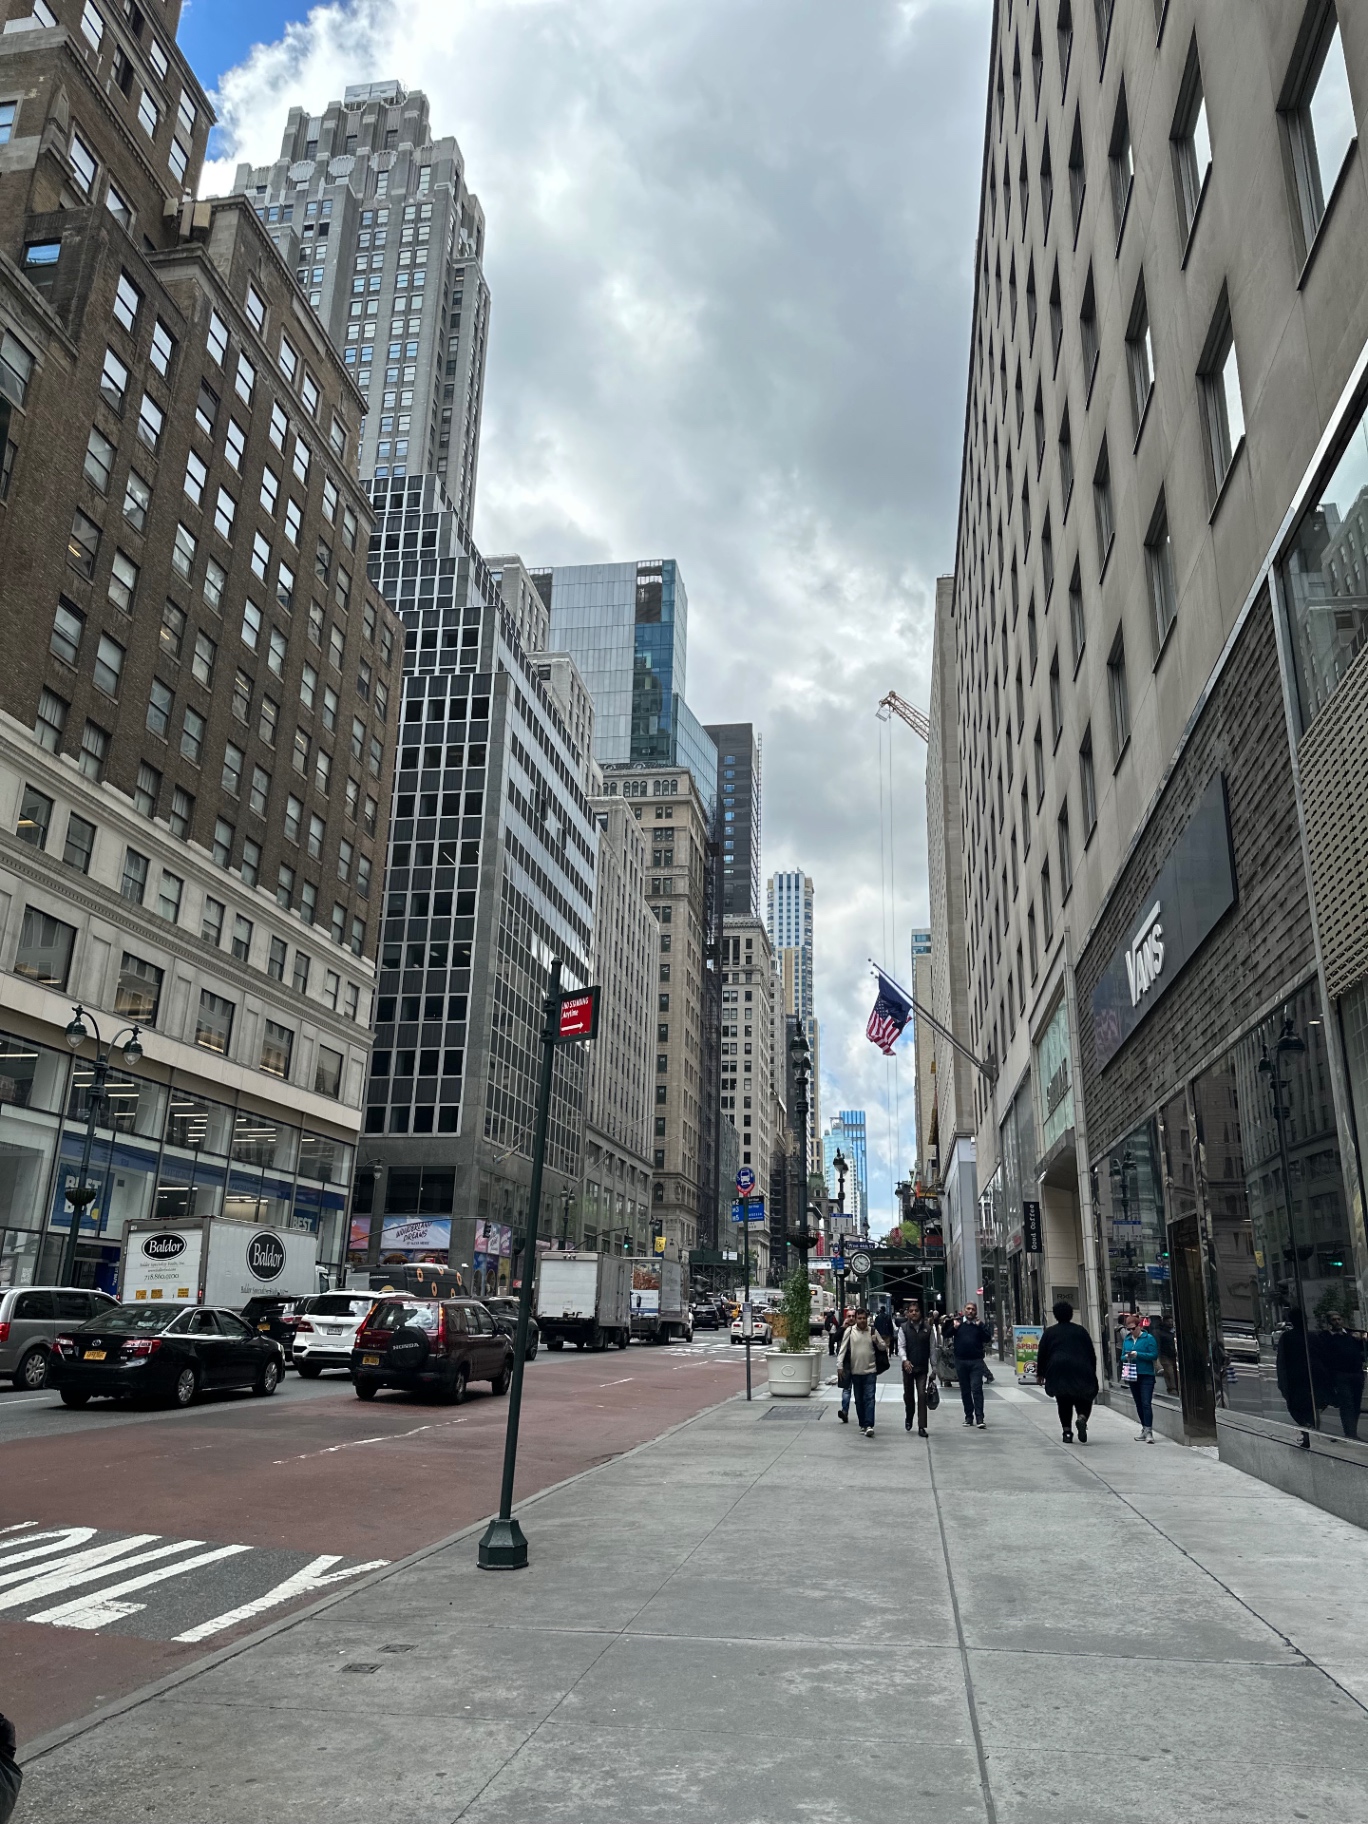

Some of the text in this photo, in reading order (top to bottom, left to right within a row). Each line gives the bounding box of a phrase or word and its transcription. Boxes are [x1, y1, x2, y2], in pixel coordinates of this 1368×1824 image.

[1125, 900, 1164, 1007] VANS
[292, 1216, 313, 1232] BEST
[1029, 1204, 1037, 1230] Coffee
[148, 1239, 183, 1254] Baldor
[252, 1242, 283, 1268] Baldor
[392, 1342, 420, 1350] HONDA
